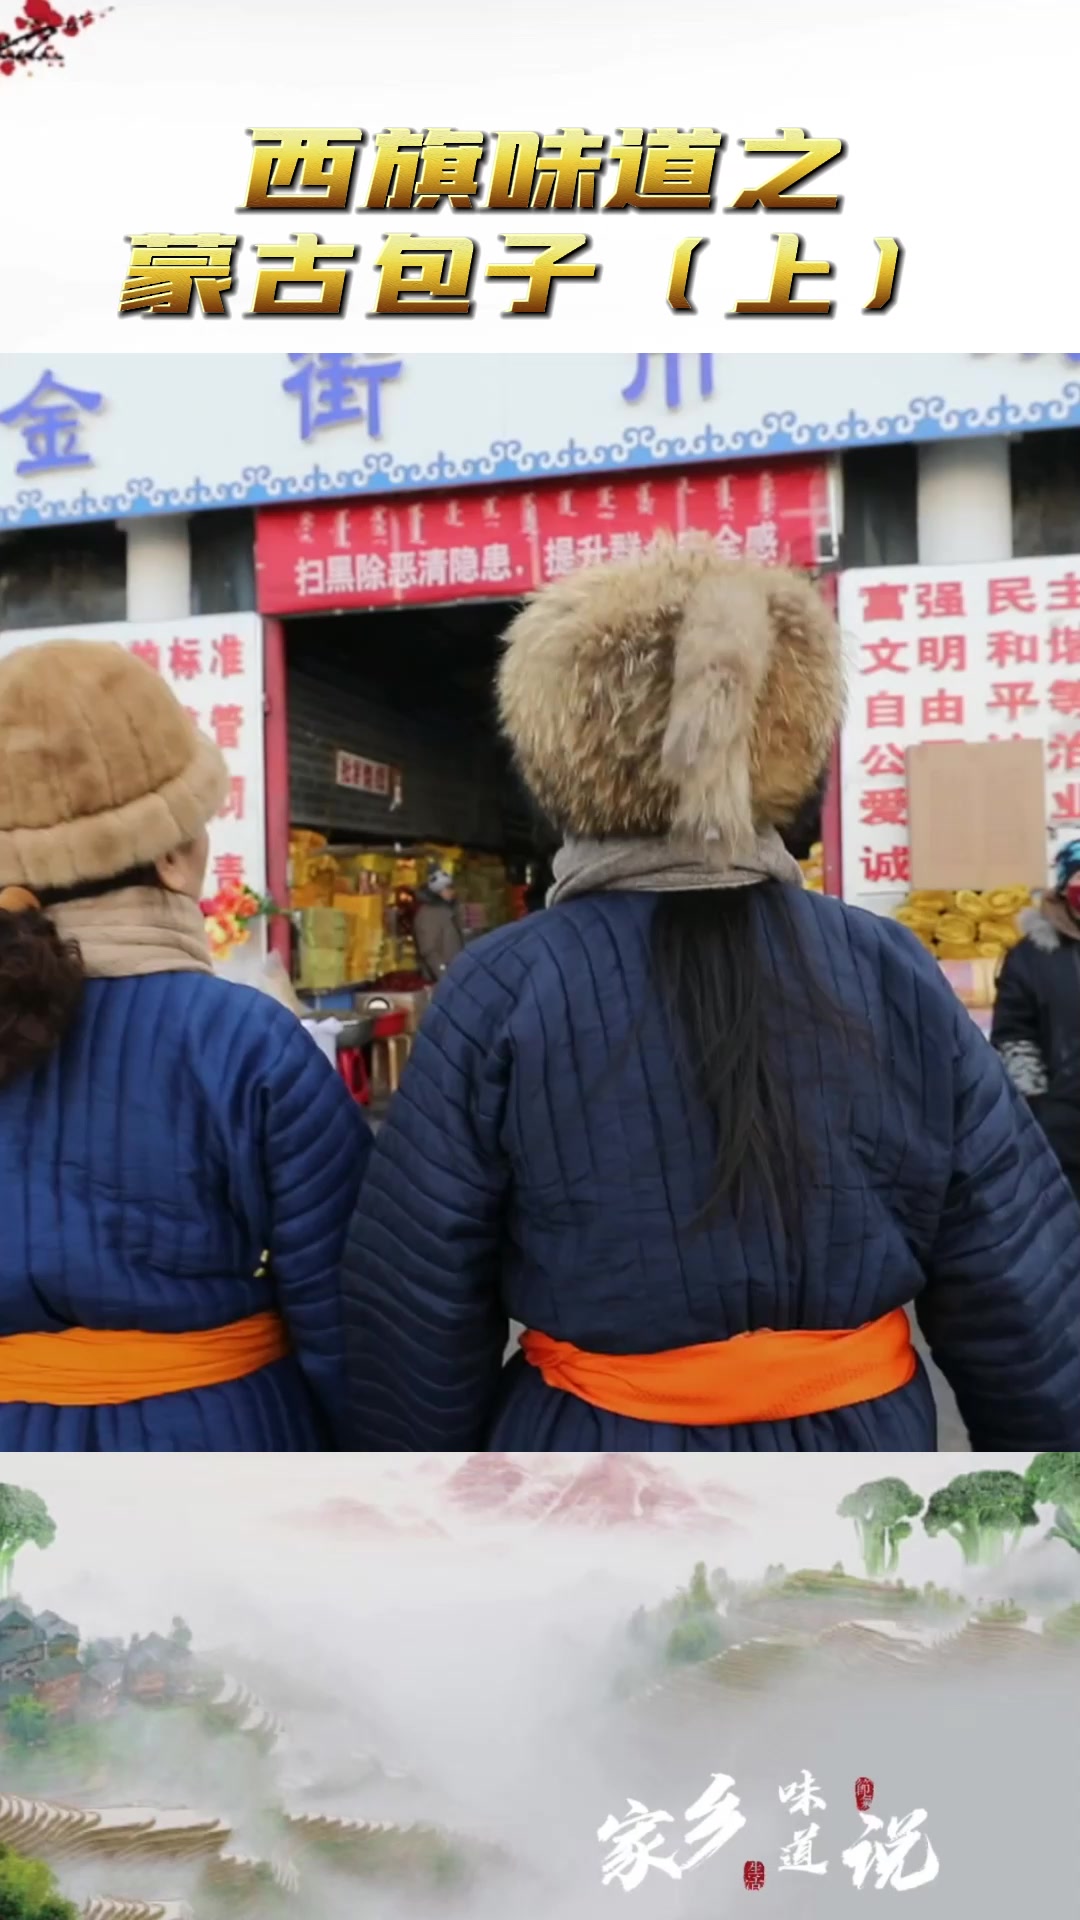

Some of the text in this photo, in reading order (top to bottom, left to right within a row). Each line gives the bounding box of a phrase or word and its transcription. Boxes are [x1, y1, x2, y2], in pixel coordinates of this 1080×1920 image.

[859, 573, 1080, 621] 富强 民主
[860, 635, 966, 674] 文明
[865, 688, 965, 729] 自由
